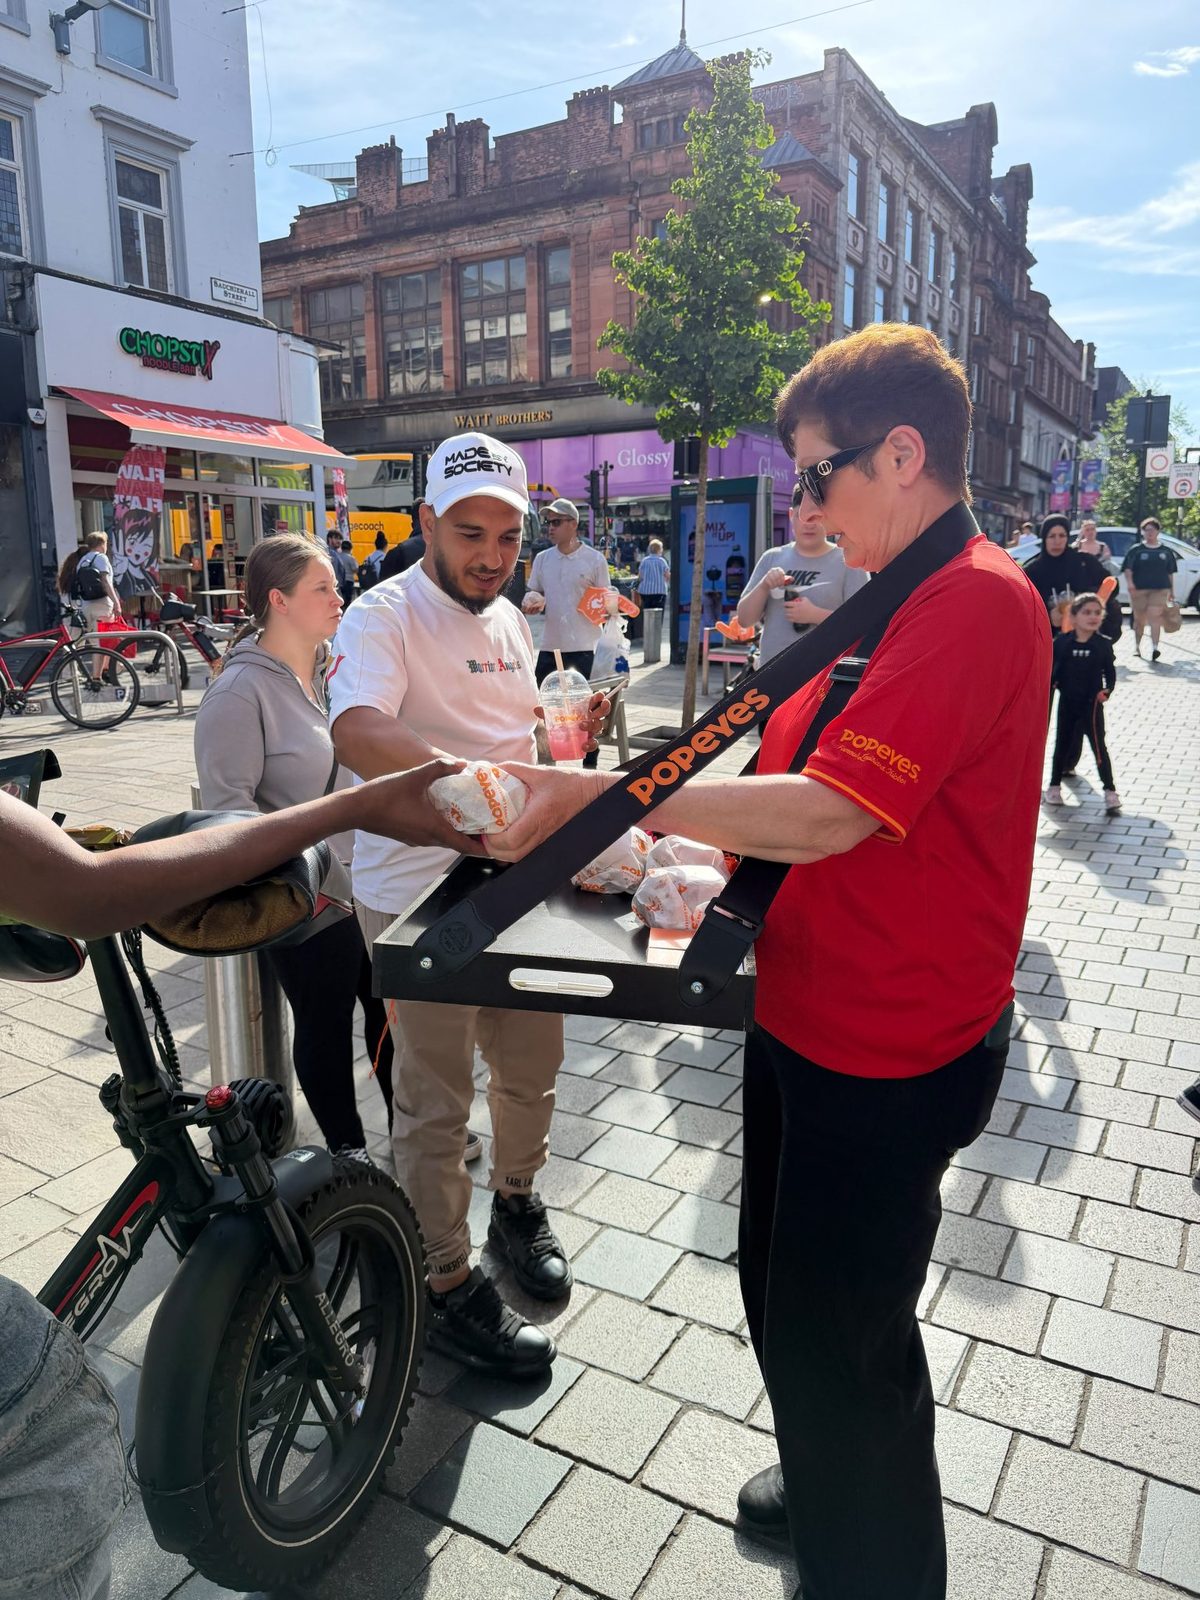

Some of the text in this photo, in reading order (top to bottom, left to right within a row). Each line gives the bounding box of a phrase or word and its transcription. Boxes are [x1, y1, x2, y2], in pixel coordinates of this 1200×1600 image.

[223, 290, 247, 302] STREET
[119, 327, 221, 380] CHOPSTIX
[142, 356, 197, 376] NOODLE BAR
[112, 403, 286, 443] CHOPSTIX
[455, 410, 553, 428] WATT BROTHERS
[444, 446, 491, 466] MADE
[617, 448, 671, 468] Glossy
[444, 460, 513, 479] SOCIETY
[505, 1176, 522, 1188] KARL
[315, 1291, 354, 1367] ALLEGRO
